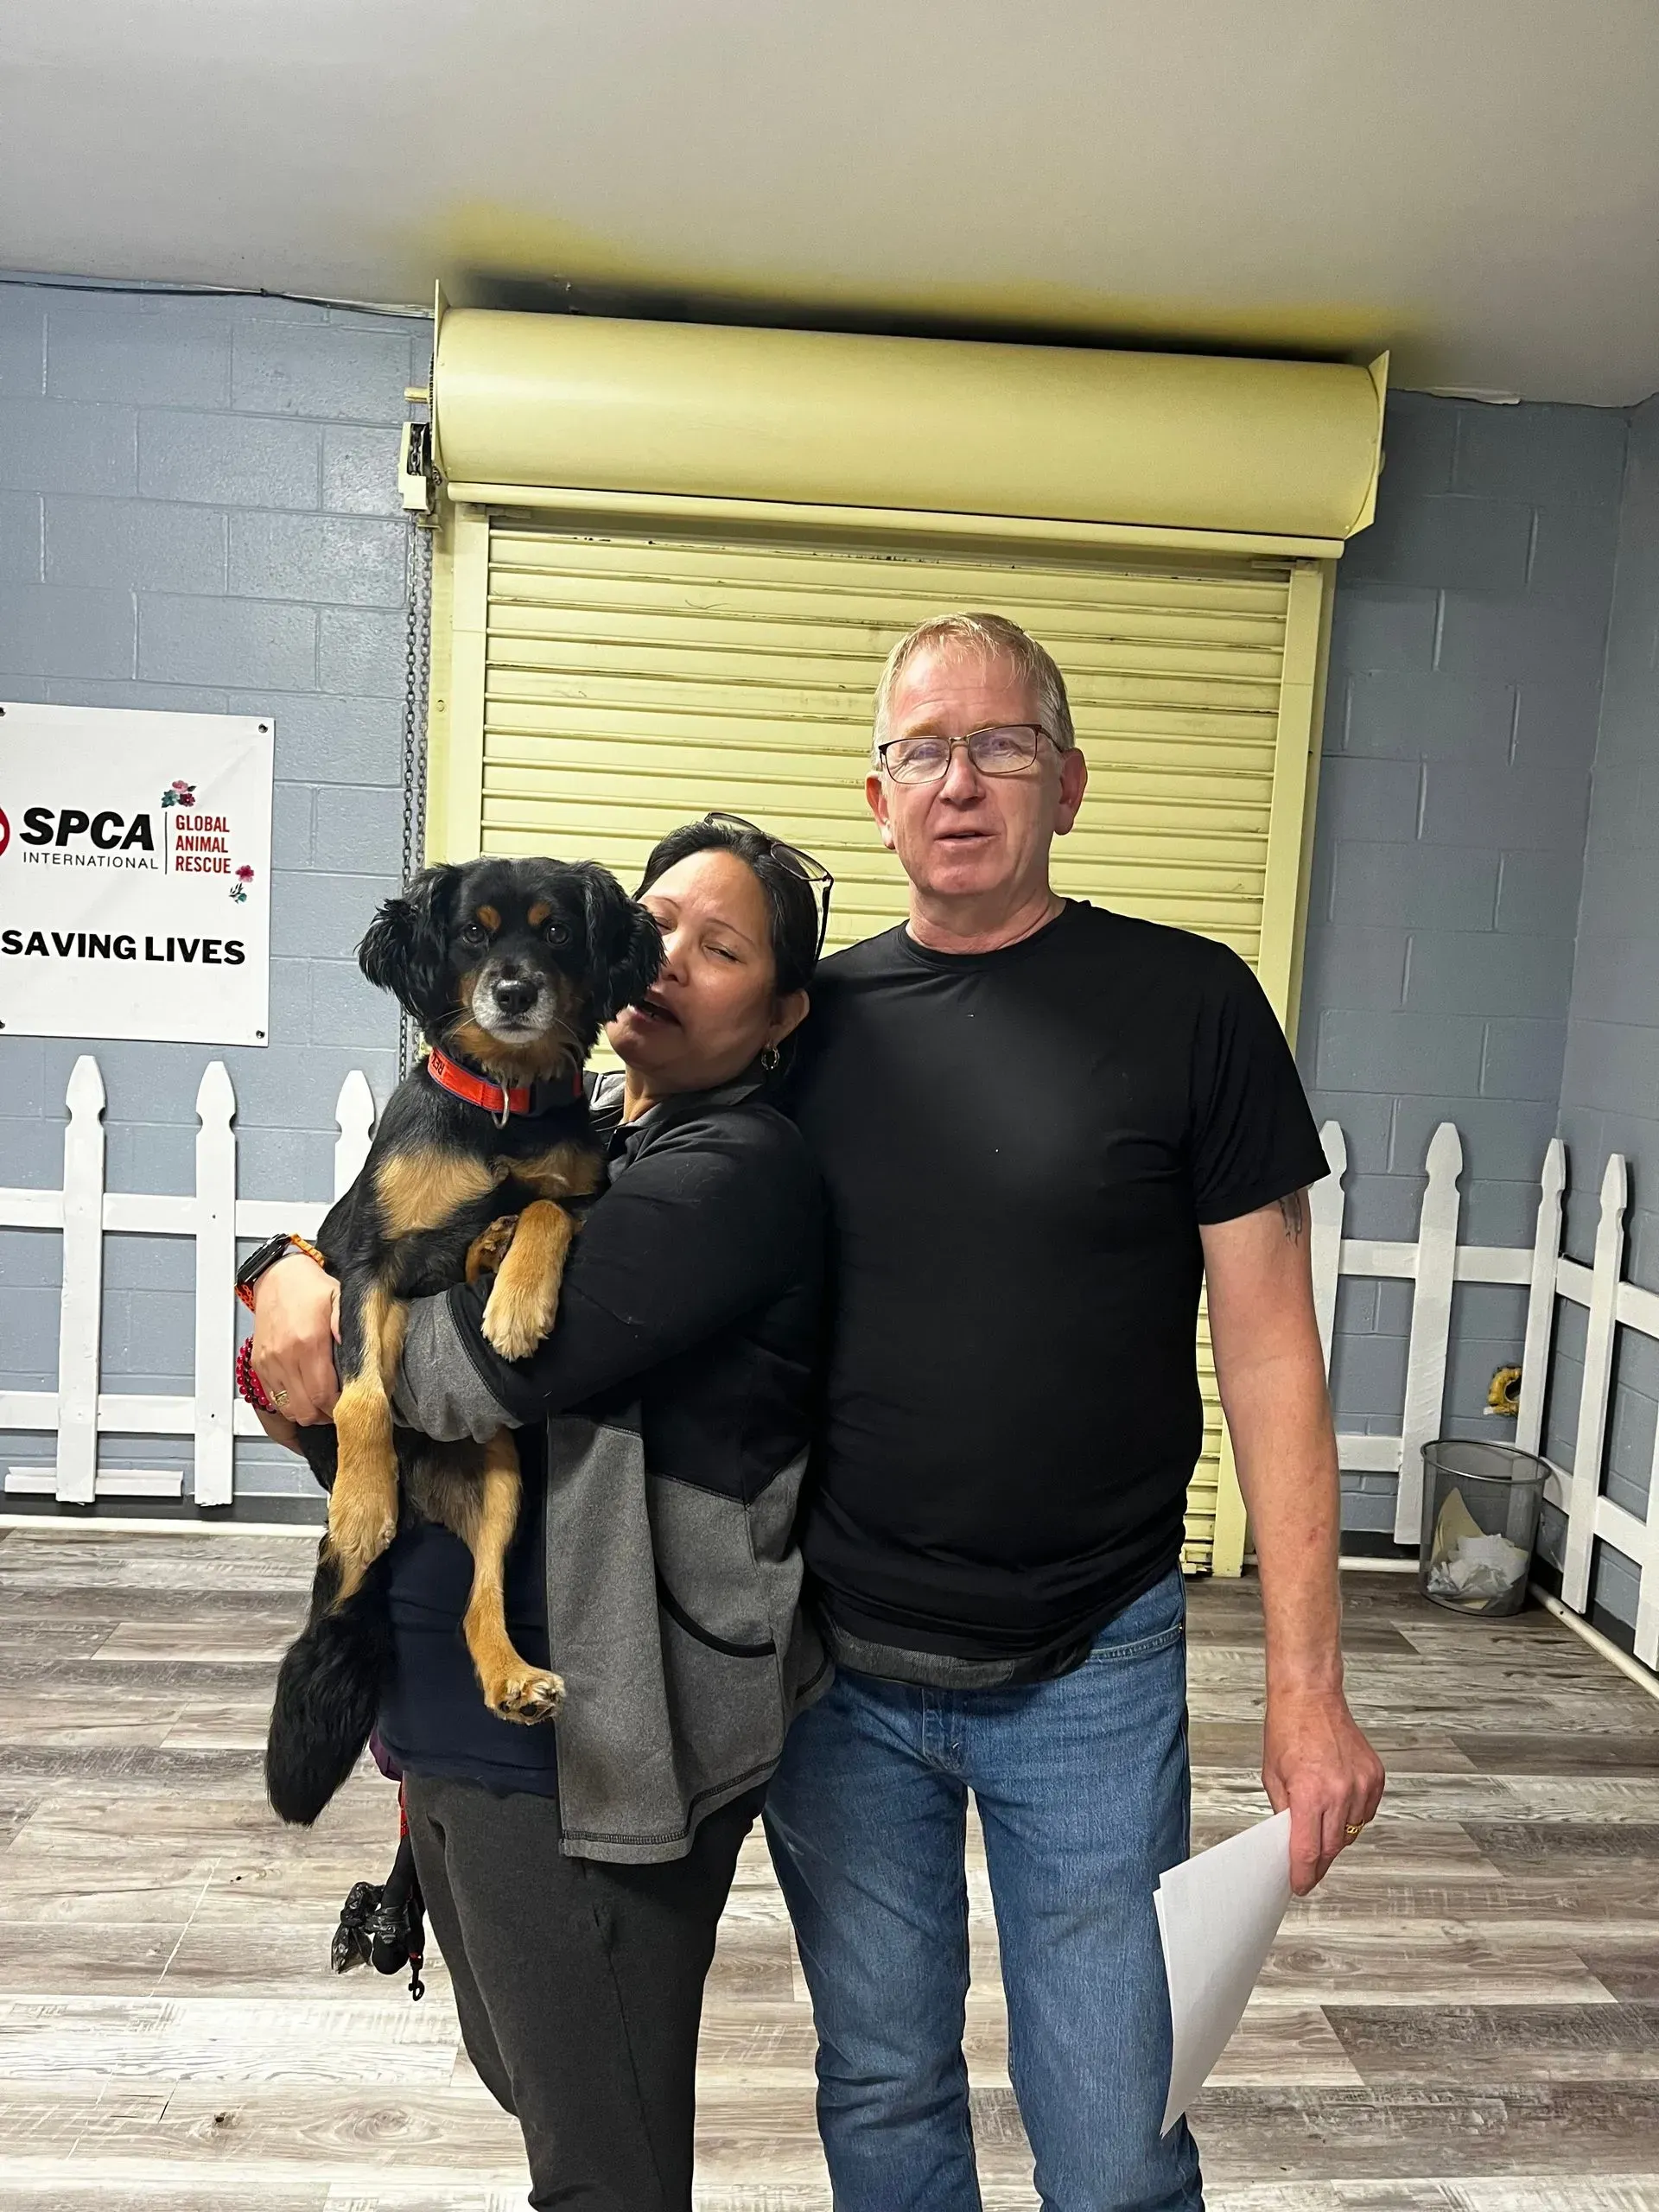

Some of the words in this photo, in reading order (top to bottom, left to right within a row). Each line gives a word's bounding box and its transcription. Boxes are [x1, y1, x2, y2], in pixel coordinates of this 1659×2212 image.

[19, 807, 155, 852] SPCA
[175, 814, 231, 834] GLOBAL
[175, 836, 229, 854] ANIMAL
[23, 851, 159, 870] INTERNATIONAL
[175, 855, 232, 874] RESCUE
[1, 930, 137, 961] SAVING
[145, 936, 246, 966] LIVES
